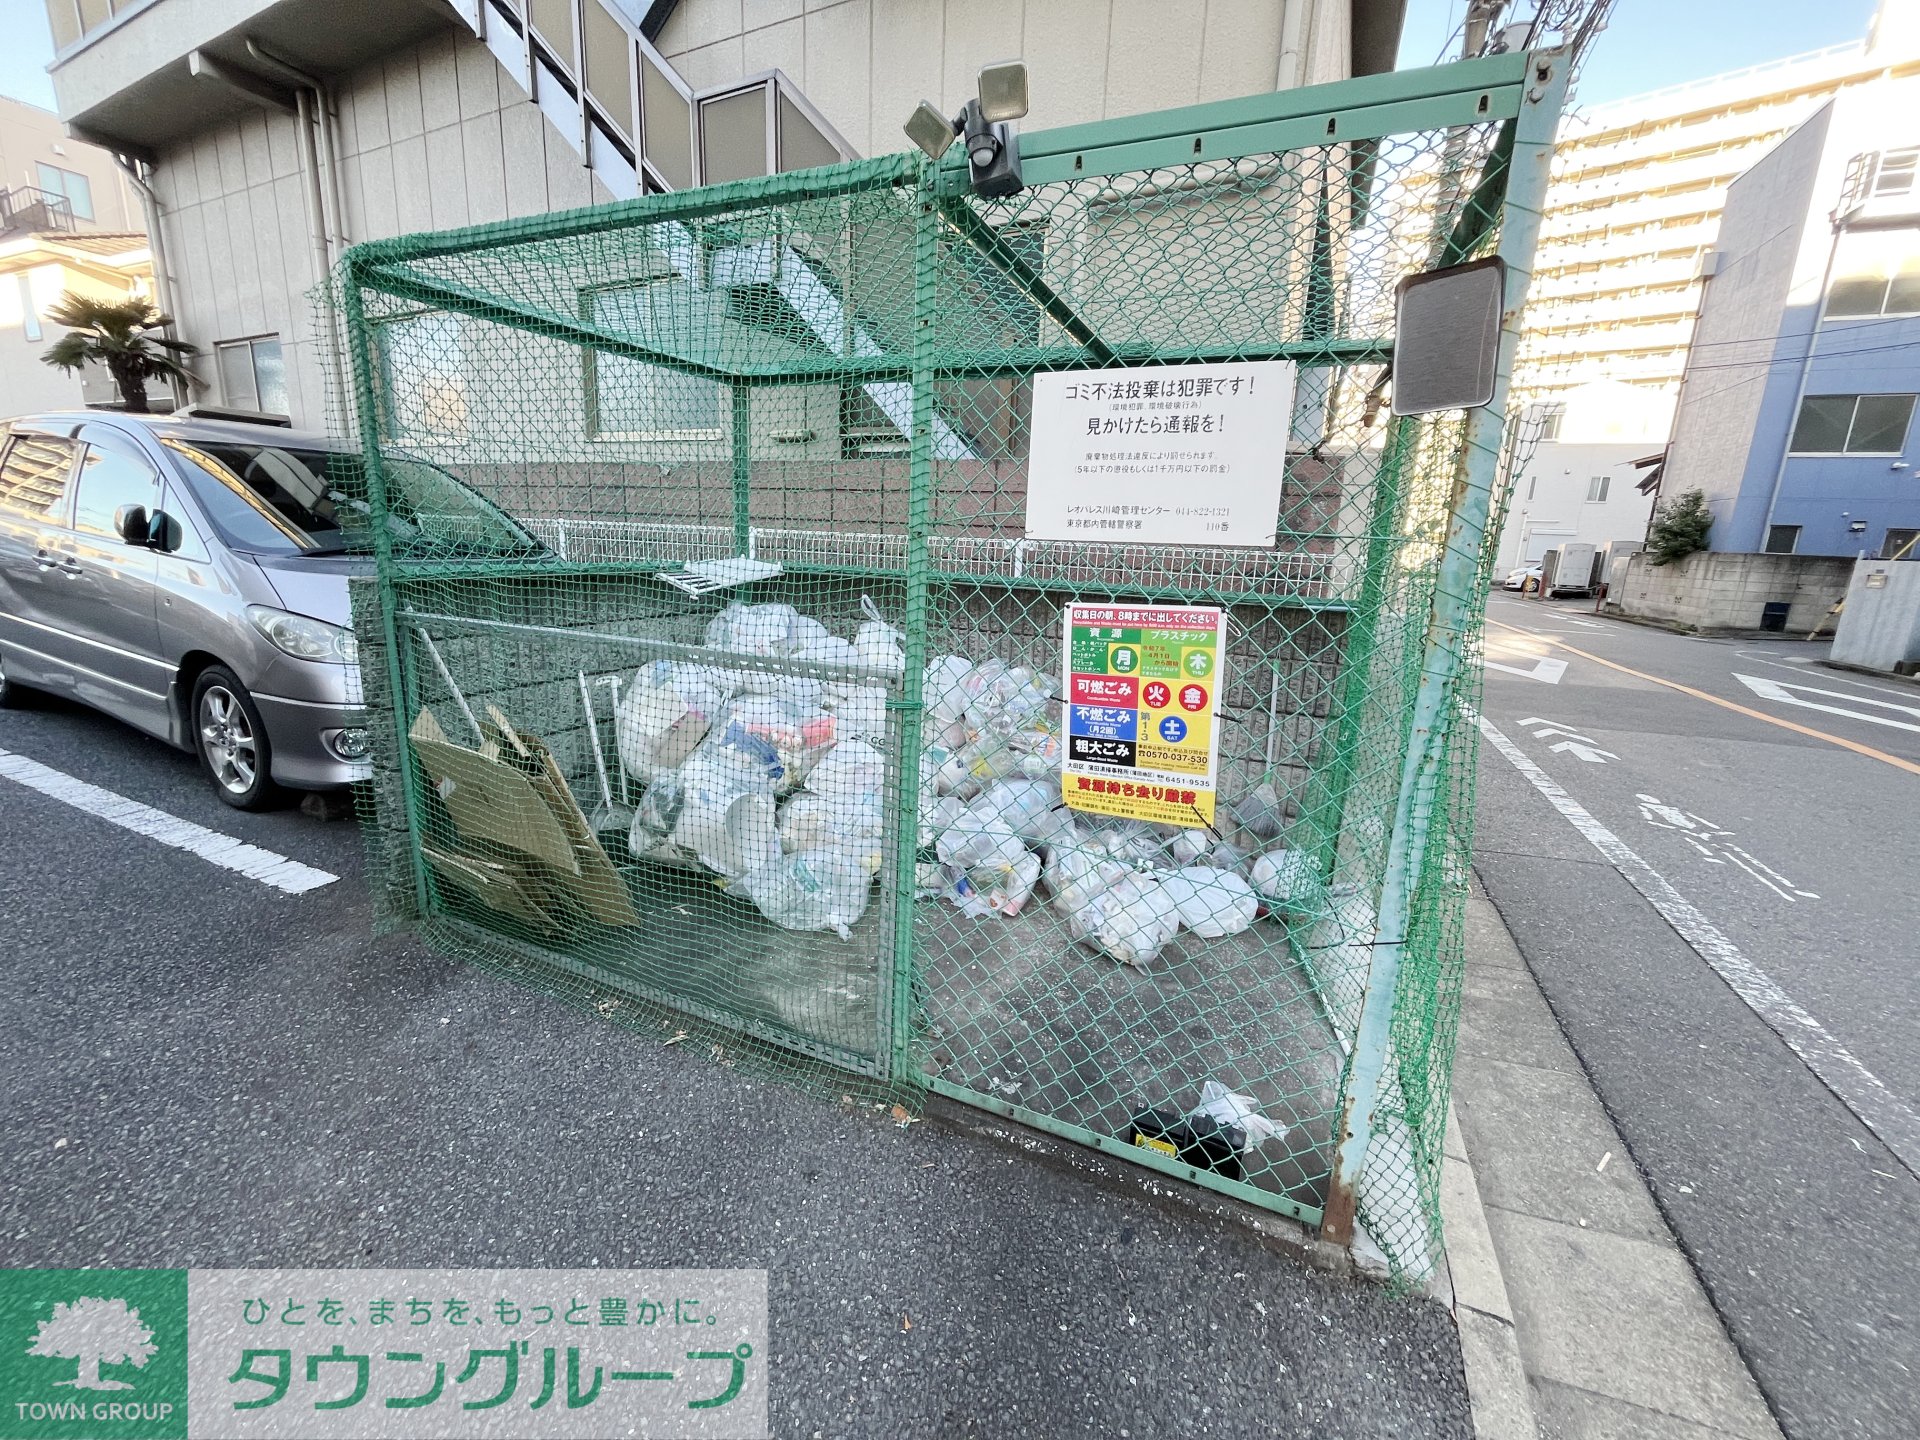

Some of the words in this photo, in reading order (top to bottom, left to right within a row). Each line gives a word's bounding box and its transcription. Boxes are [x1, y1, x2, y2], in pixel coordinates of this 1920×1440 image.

[1065, 375, 1255, 400] ゴミ不法投棄は犯罪です！
[1086, 414, 1225, 436] 見かけたら通報を！
[1067, 505, 1170, 515] レオパレス川崎管理センター
[1067, 519, 1142, 530] 東京都内管轄警察署
[1073, 609, 1217, 624] 収集日の朝、8時までに出してください。
[1151, 630, 1208, 642] プラスチック
[1116, 649, 1131, 666] 月
[1190, 653, 1207, 670] 木
[1077, 679, 1132, 696] 可燃ごみ
[1148, 685, 1164, 701] 火
[1184, 688, 1201, 705] 金
[1076, 706, 1131, 723] 不燃ごみ
[1090, 725, 1117, 735] （月2回）
[1165, 720, 1180, 735] 土
[1075, 739, 1130, 758] 粗大ごみ
[1146, 750, 1208, 764] 0570-037-530
[1166, 777, 1210, 787] 6451-9535
[1078, 777, 1196, 805] 資源持ち去り厳禁
